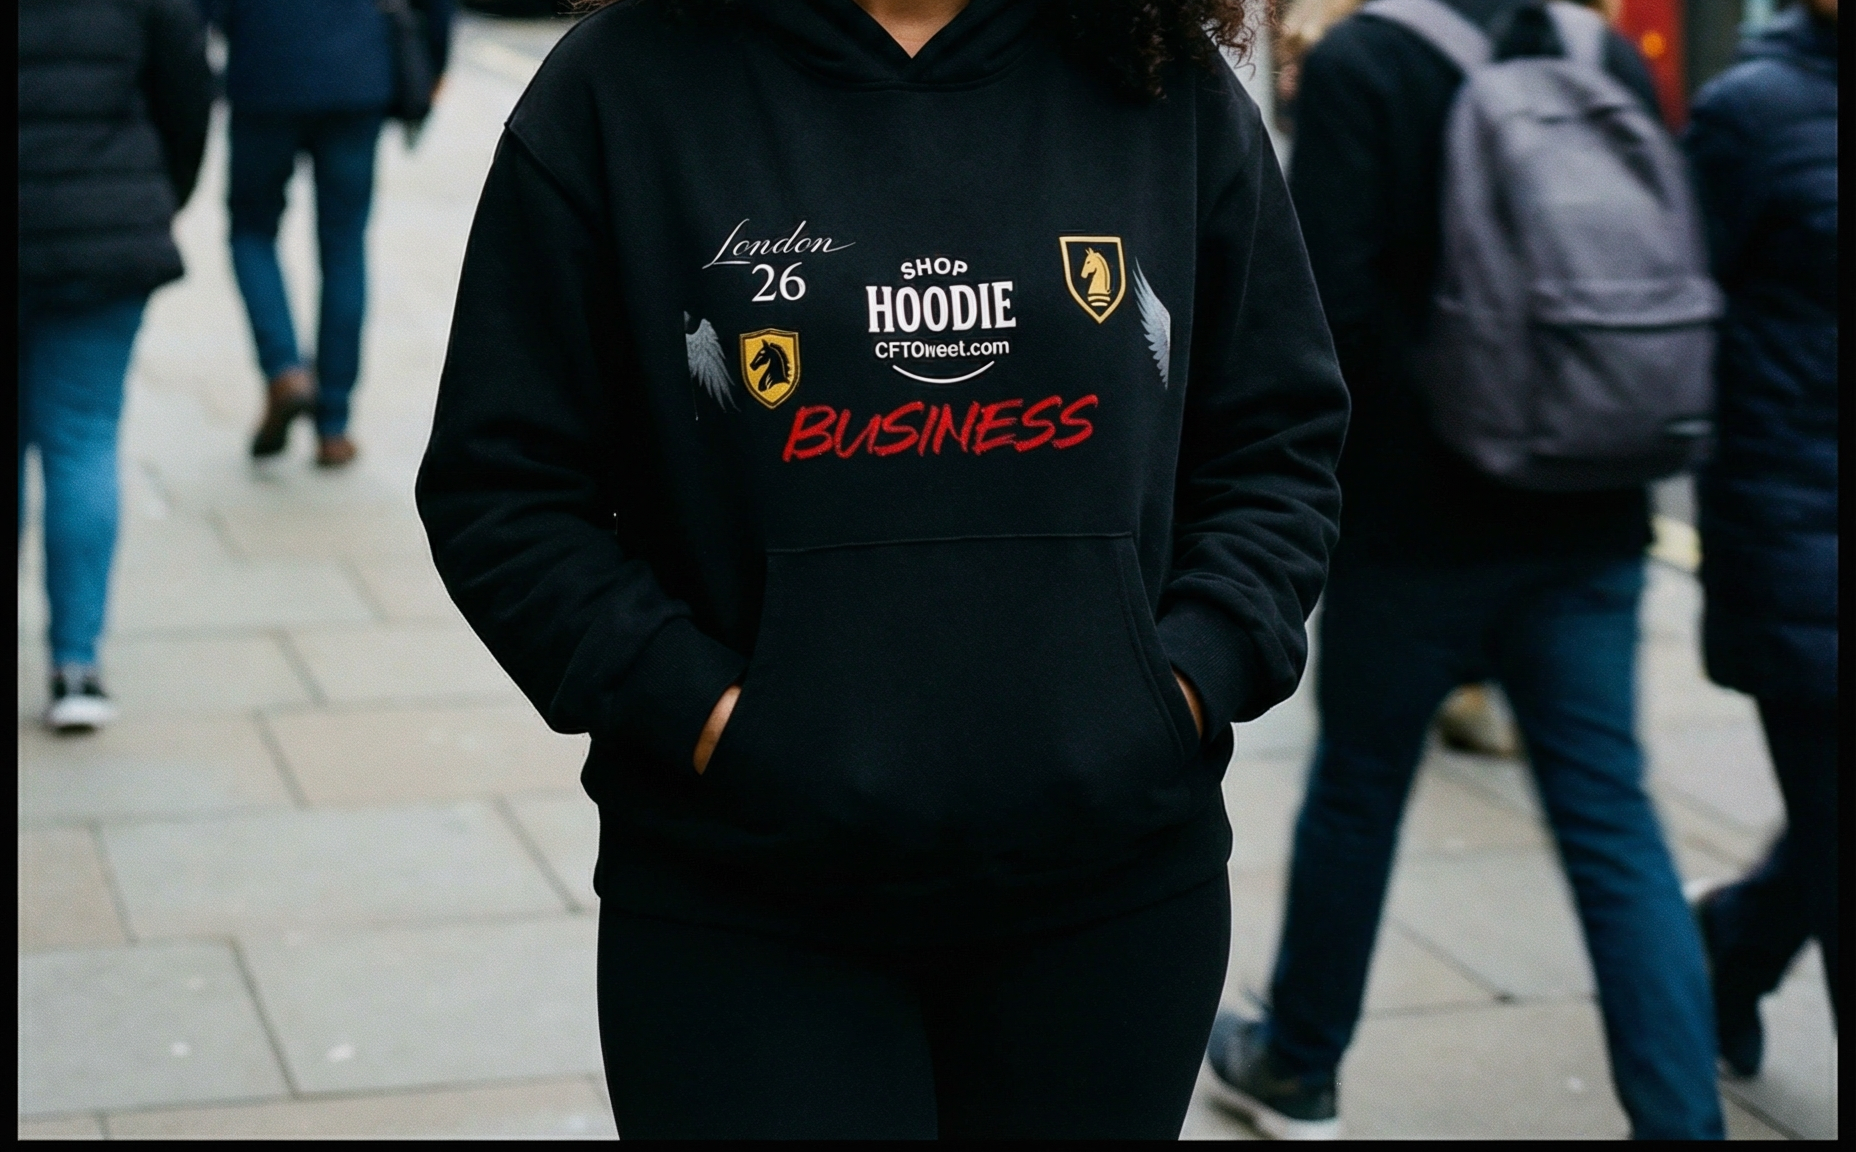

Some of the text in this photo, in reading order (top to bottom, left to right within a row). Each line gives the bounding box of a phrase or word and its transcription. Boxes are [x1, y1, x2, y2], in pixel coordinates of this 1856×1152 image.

[702, 219, 856, 269] London
[901, 257, 969, 280] SHOP
[752, 262, 807, 302] 26
[866, 281, 1017, 333] HOODIE
[782, 394, 1099, 462] BUSINESS
